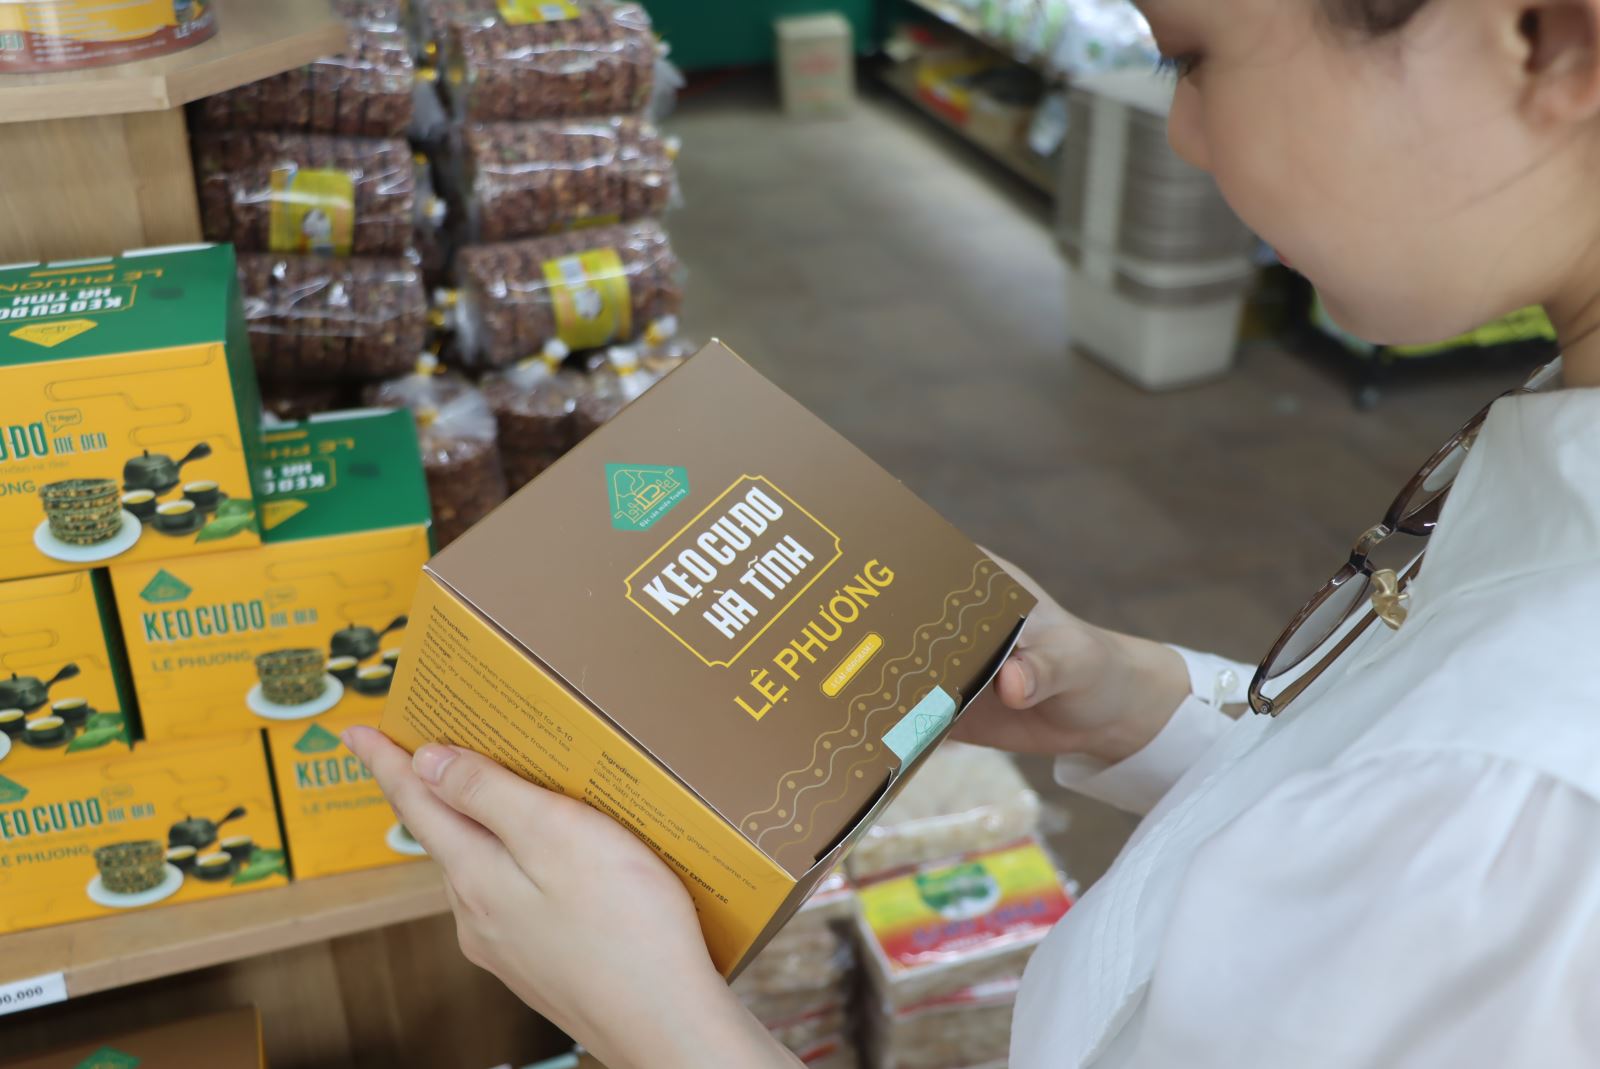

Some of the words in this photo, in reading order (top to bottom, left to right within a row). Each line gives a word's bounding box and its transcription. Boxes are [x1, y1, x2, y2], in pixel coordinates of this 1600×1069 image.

[642, 547, 718, 616] KẸO
[702, 588, 759, 640] HÀ
[739, 534, 815, 601] TĨNH
[733, 667, 790, 722] LỆ
[772, 558, 895, 682] PHƯƠNG
[407, 694, 442, 733] Production
[412, 675, 438, 705] Product
[415, 666, 430, 685] Food
[430, 681, 449, 704] Safety
[417, 656, 444, 686] Business
[444, 682, 481, 720] Registration
[425, 700, 432, 710] of
[447, 663, 458, 677] dry
[459, 674, 472, 690] and
[473, 687, 488, 704] cool
[510, 720, 529, 739] away
[530, 736, 548, 754] from
[548, 751, 569, 772] direct
[457, 651, 481, 676] normal
[499, 689, 519, 709] enjoy
[519, 707, 535, 723] with
[536, 721, 557, 741] green
[478, 660, 498, 680] when
[498, 677, 542, 717] microwaved
[543, 715, 553, 726] for
[555, 725, 572, 742] 5-10
[588, 777, 636, 819] Manufactured
[625, 783, 640, 798] fruit
[711, 854, 742, 880] sesame
[741, 877, 757, 891] rice
[663, 851, 688, 873] IMPORT
[689, 871, 715, 894] EXPORT
[715, 891, 728, 904] JSC
